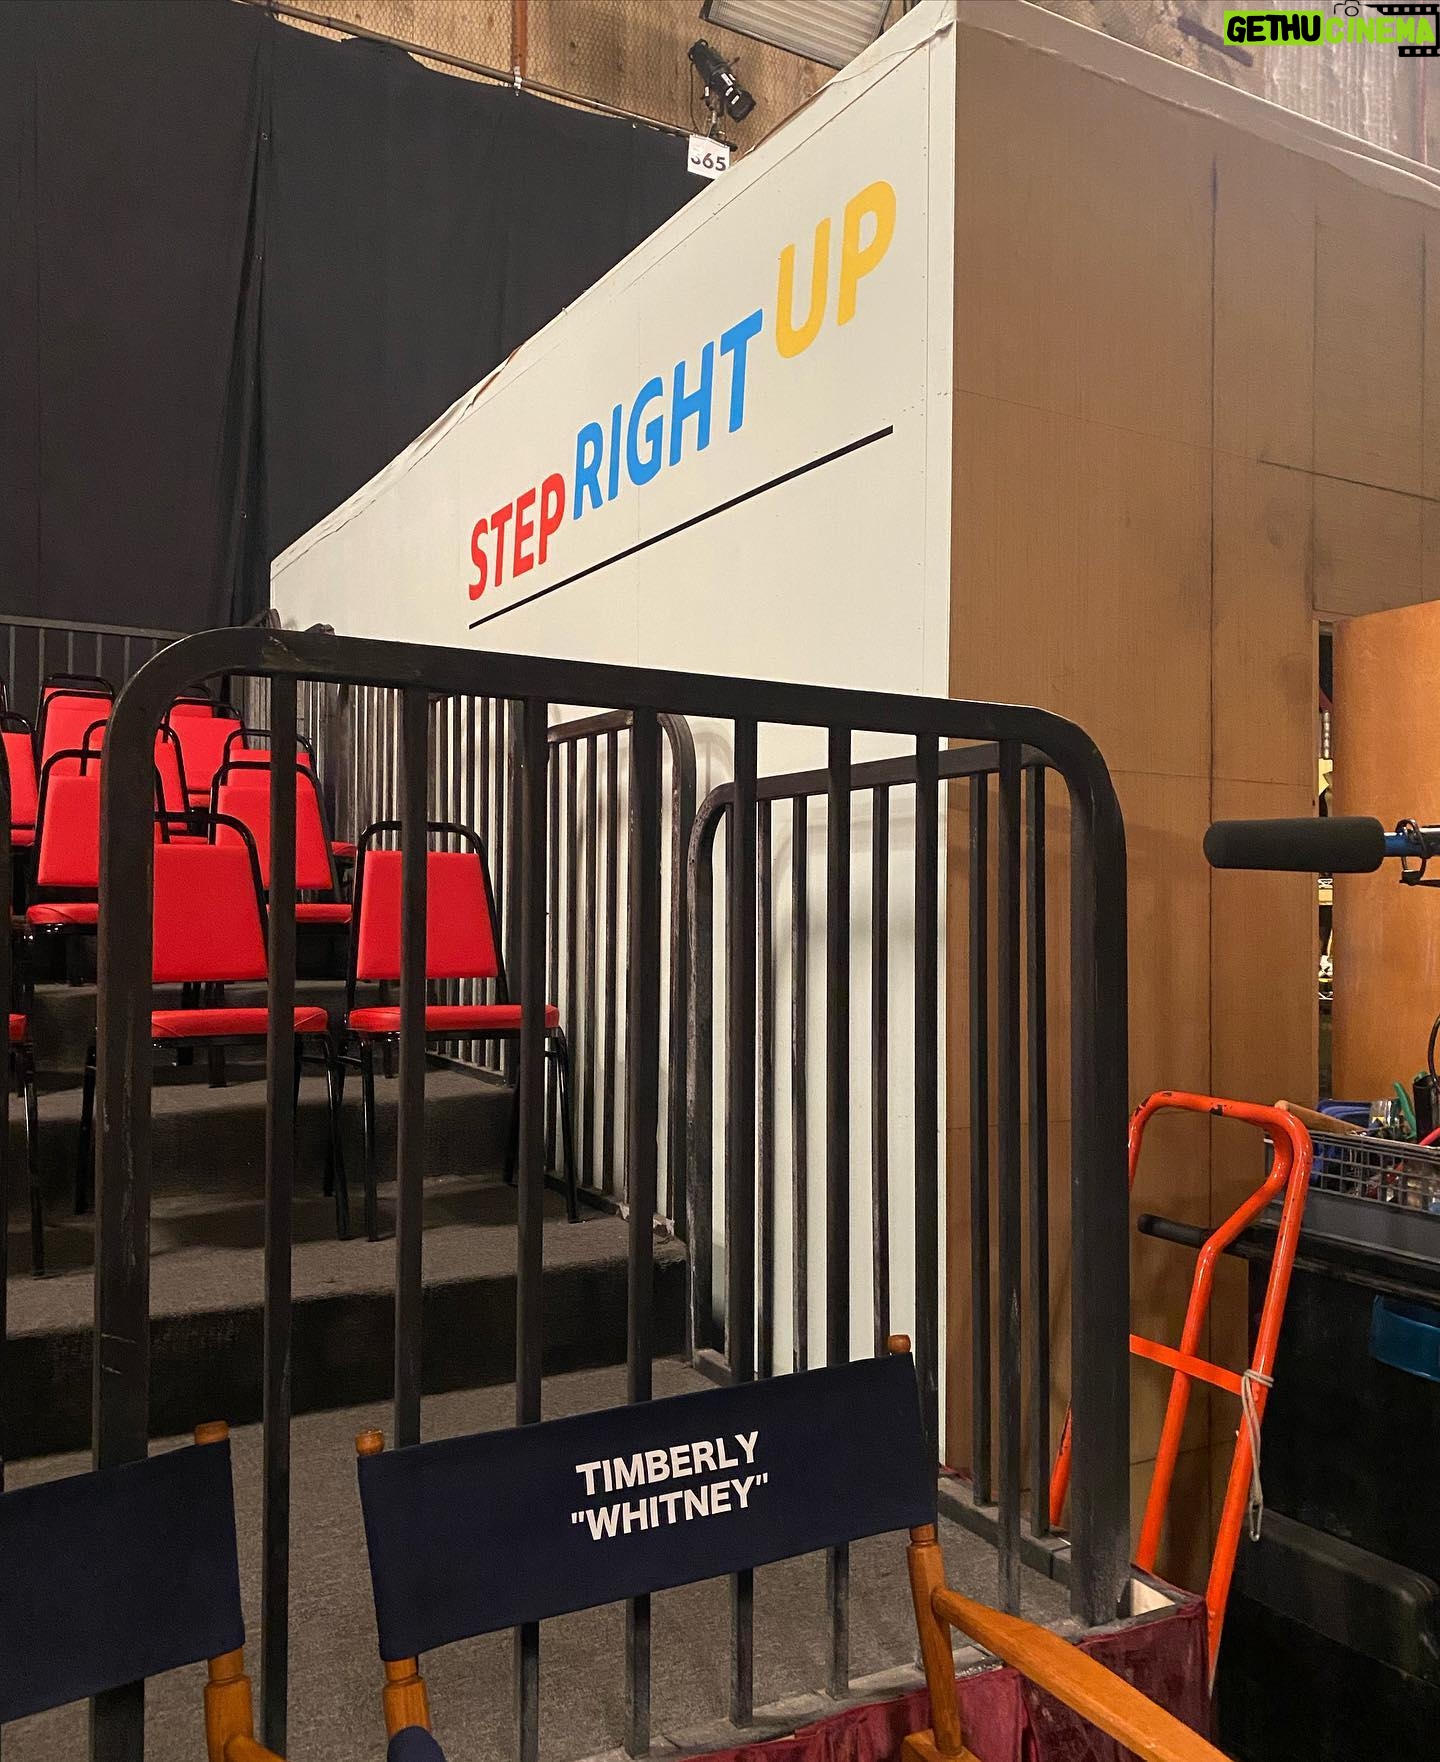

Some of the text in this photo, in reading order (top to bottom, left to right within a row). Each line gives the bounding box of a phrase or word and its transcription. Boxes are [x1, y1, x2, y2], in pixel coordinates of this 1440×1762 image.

[468, 180, 897, 601] STEP RIGHT UP
[575, 1431, 759, 1496] TIMBERLY
[571, 1472, 769, 1541] "WHITNEY"
